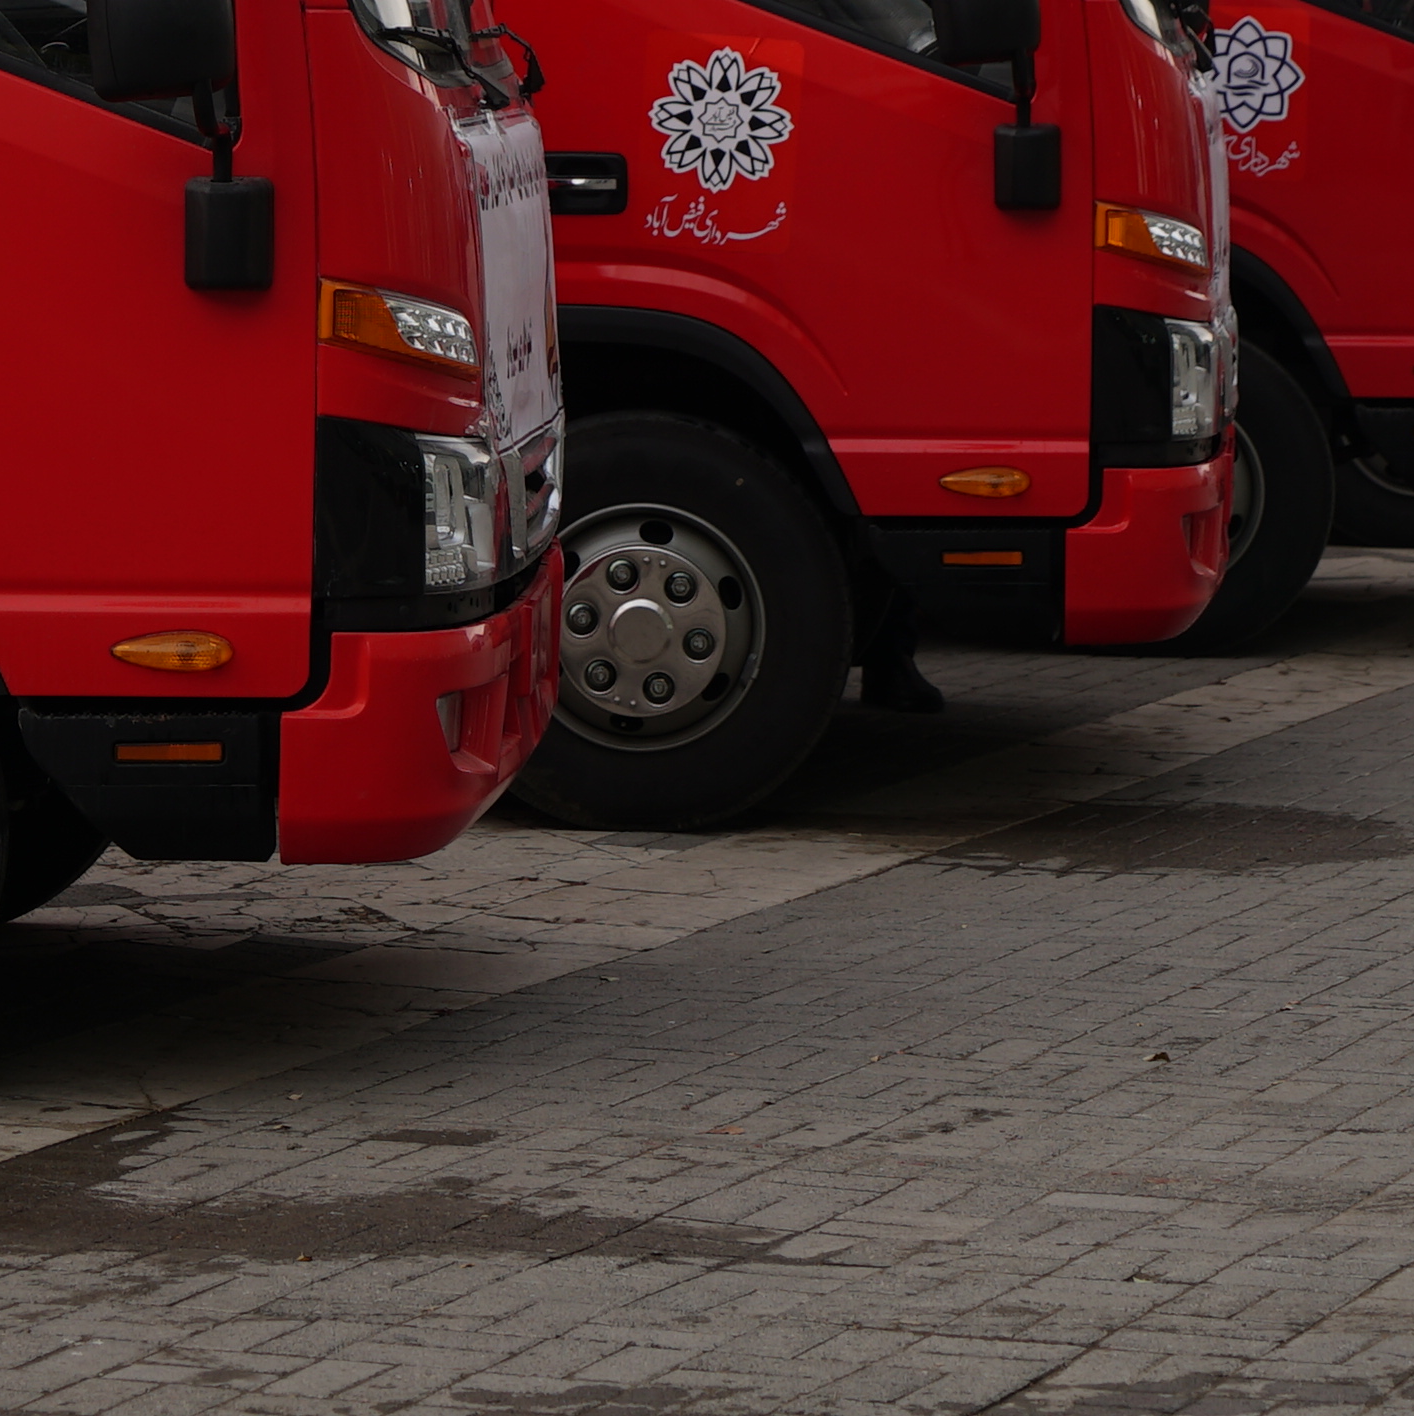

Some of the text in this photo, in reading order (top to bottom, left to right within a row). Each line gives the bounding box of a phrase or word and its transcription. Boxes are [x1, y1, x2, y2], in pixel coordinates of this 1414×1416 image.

[644, 193, 787, 245] شهرداری فیض آباد
